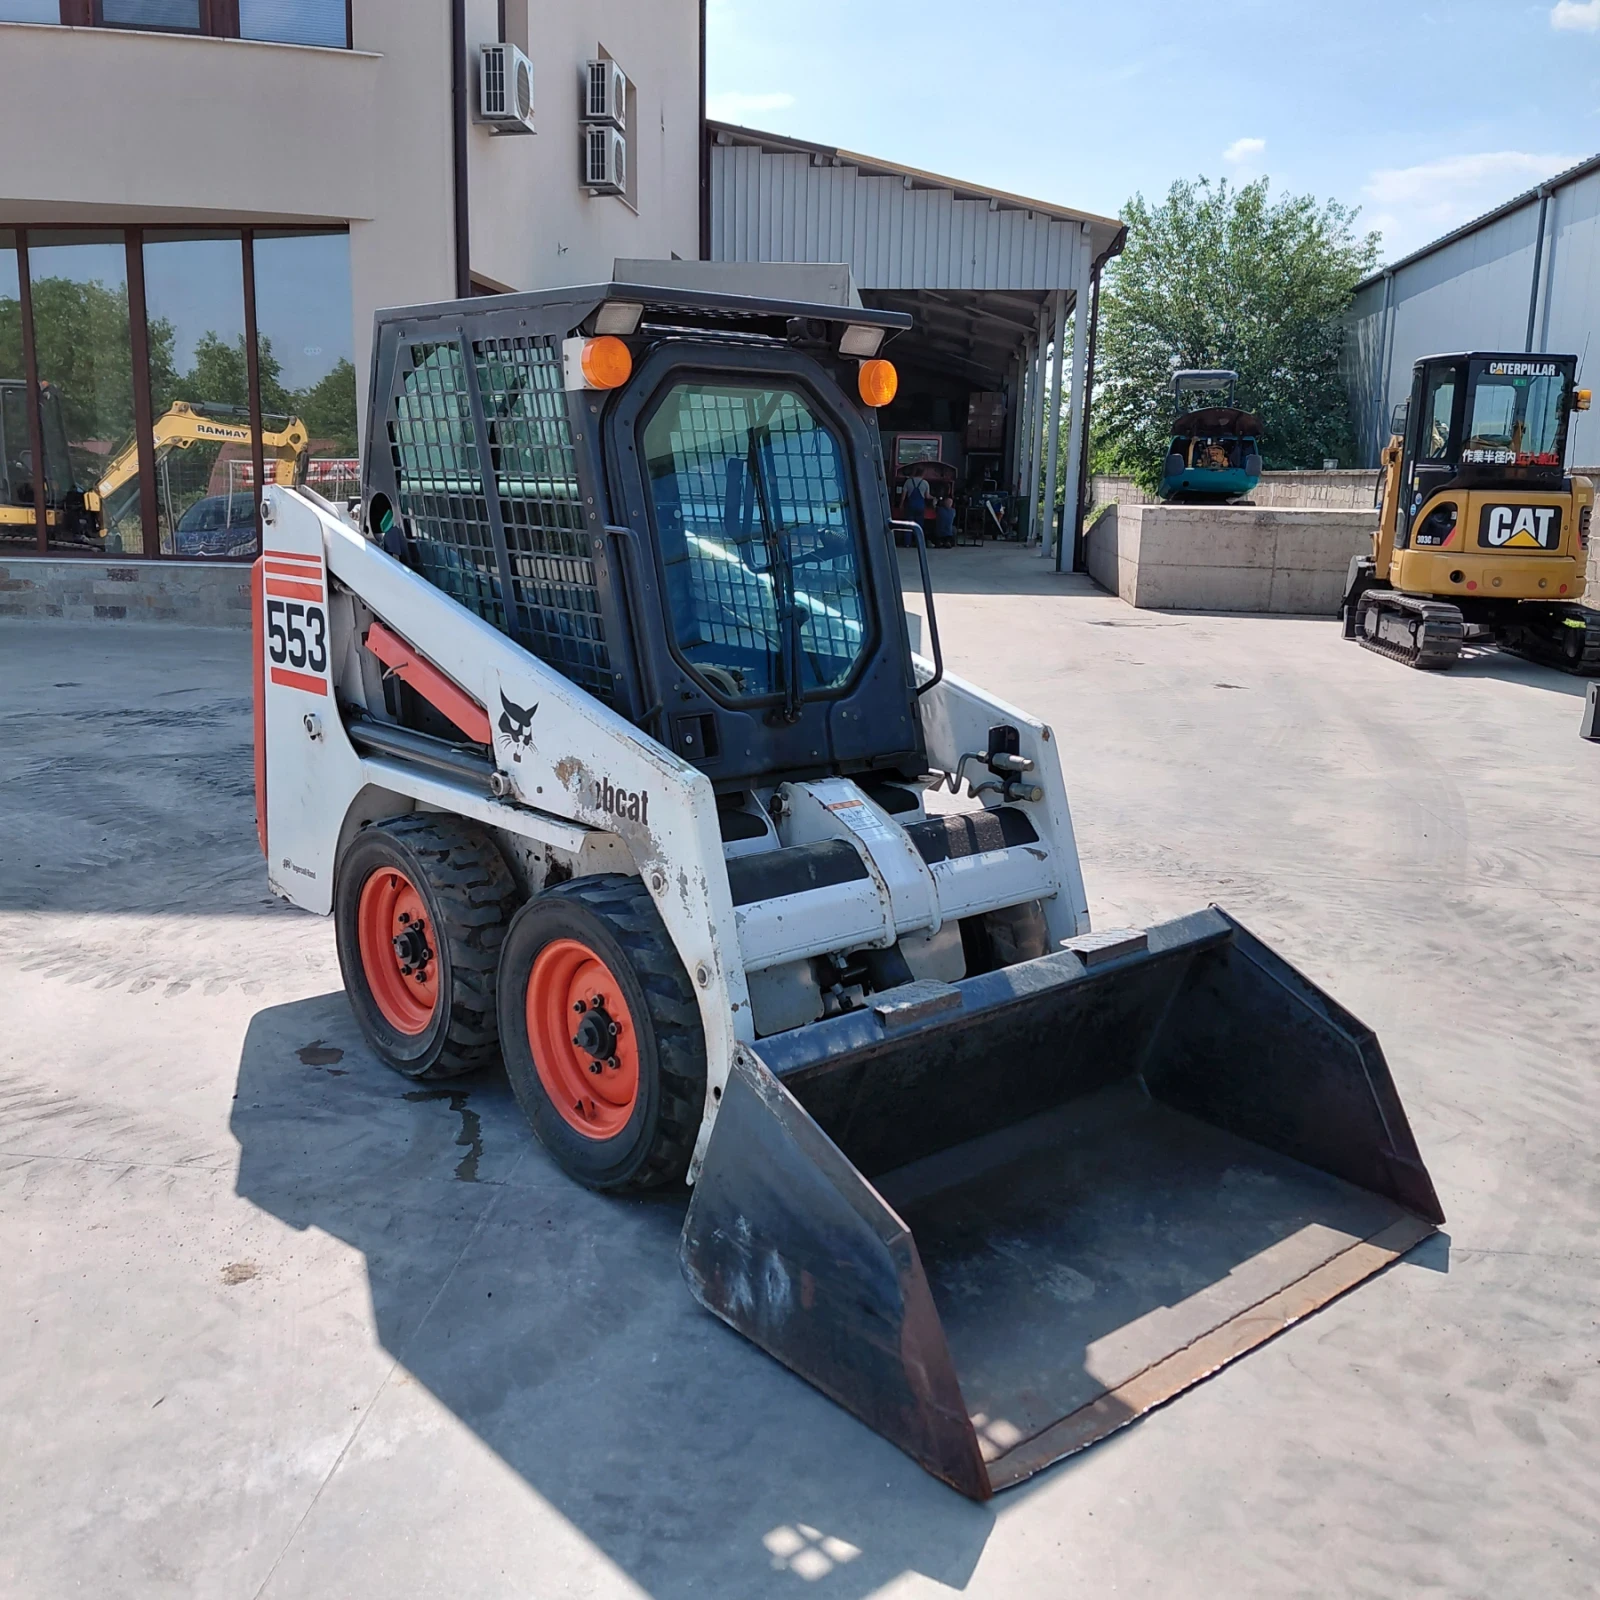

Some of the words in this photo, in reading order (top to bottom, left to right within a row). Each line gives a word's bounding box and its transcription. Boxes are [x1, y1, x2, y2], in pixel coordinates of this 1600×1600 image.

[1489, 362, 1556, 376] CATERPILLAR
[1488, 507, 1555, 548] CAT
[266, 599, 327, 673] 553
